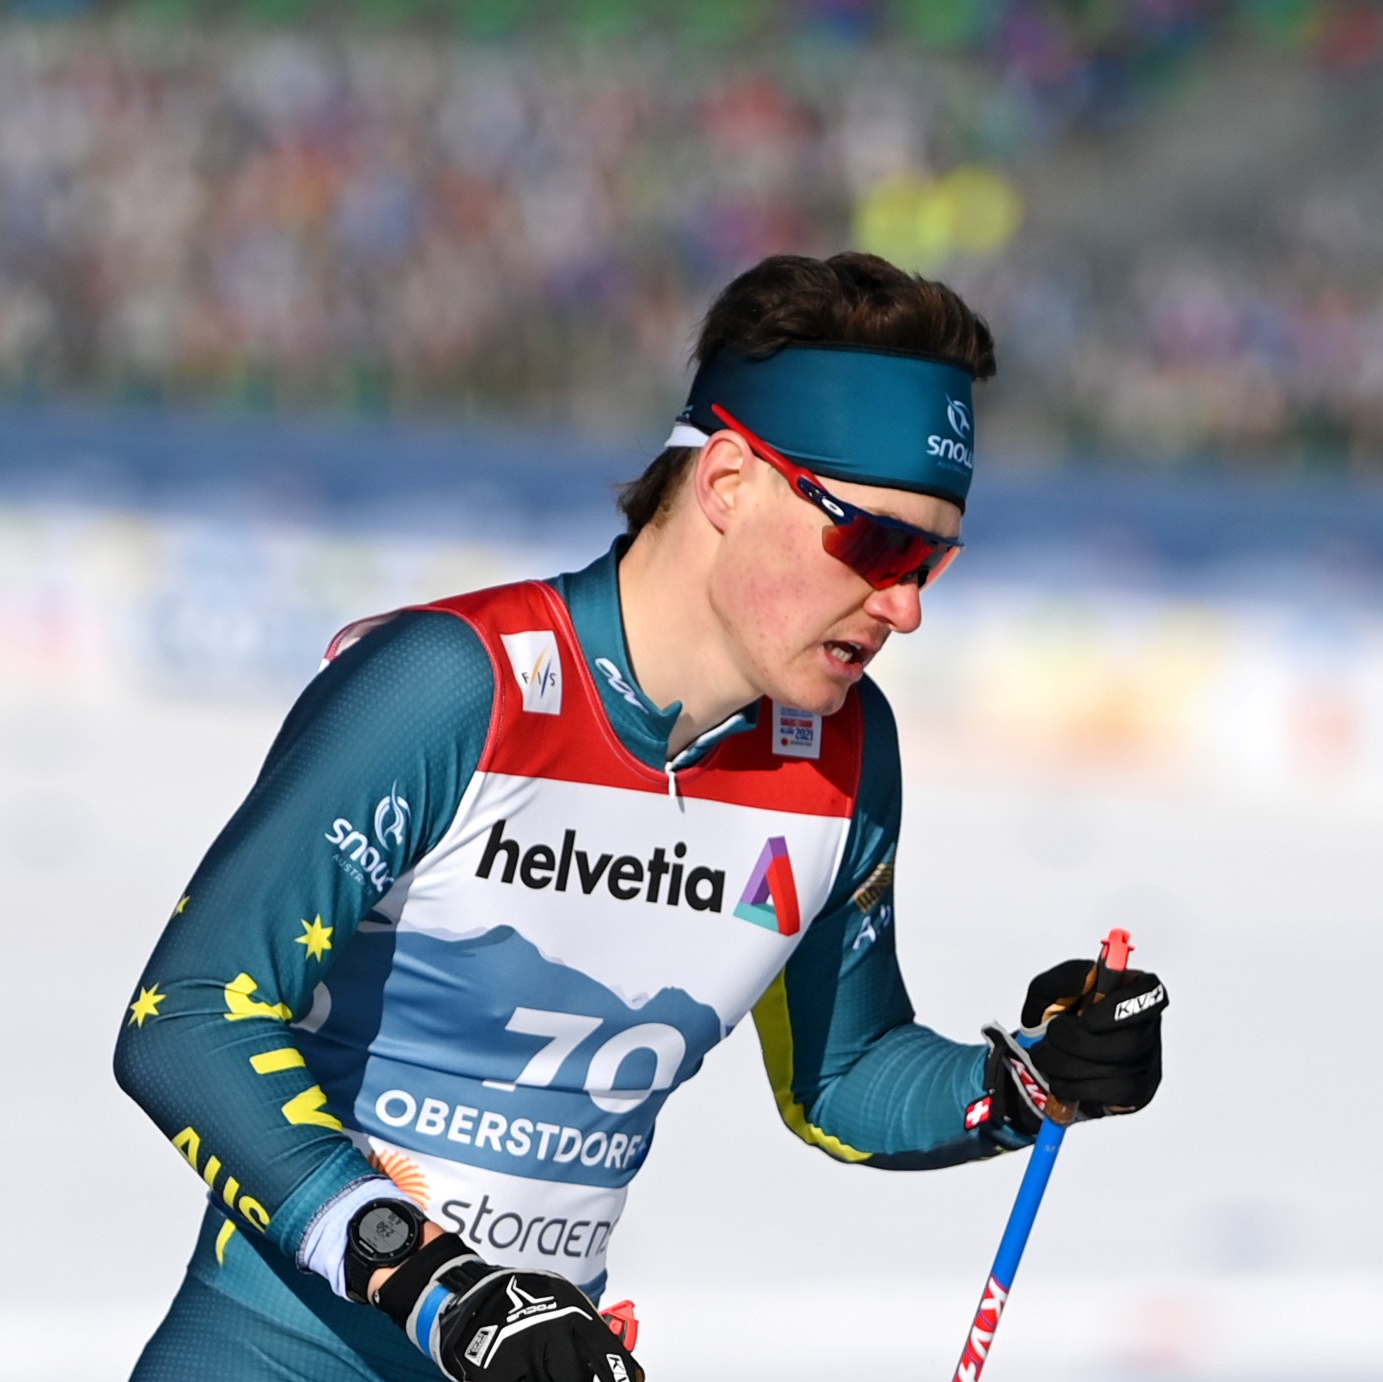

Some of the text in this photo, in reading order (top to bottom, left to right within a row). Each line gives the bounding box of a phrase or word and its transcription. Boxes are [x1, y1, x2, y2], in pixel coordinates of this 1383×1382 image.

[475, 818, 726, 914] helvetia
[482, 1006, 687, 1114] 70
[374, 1089, 643, 1170] OBERSTDORF
